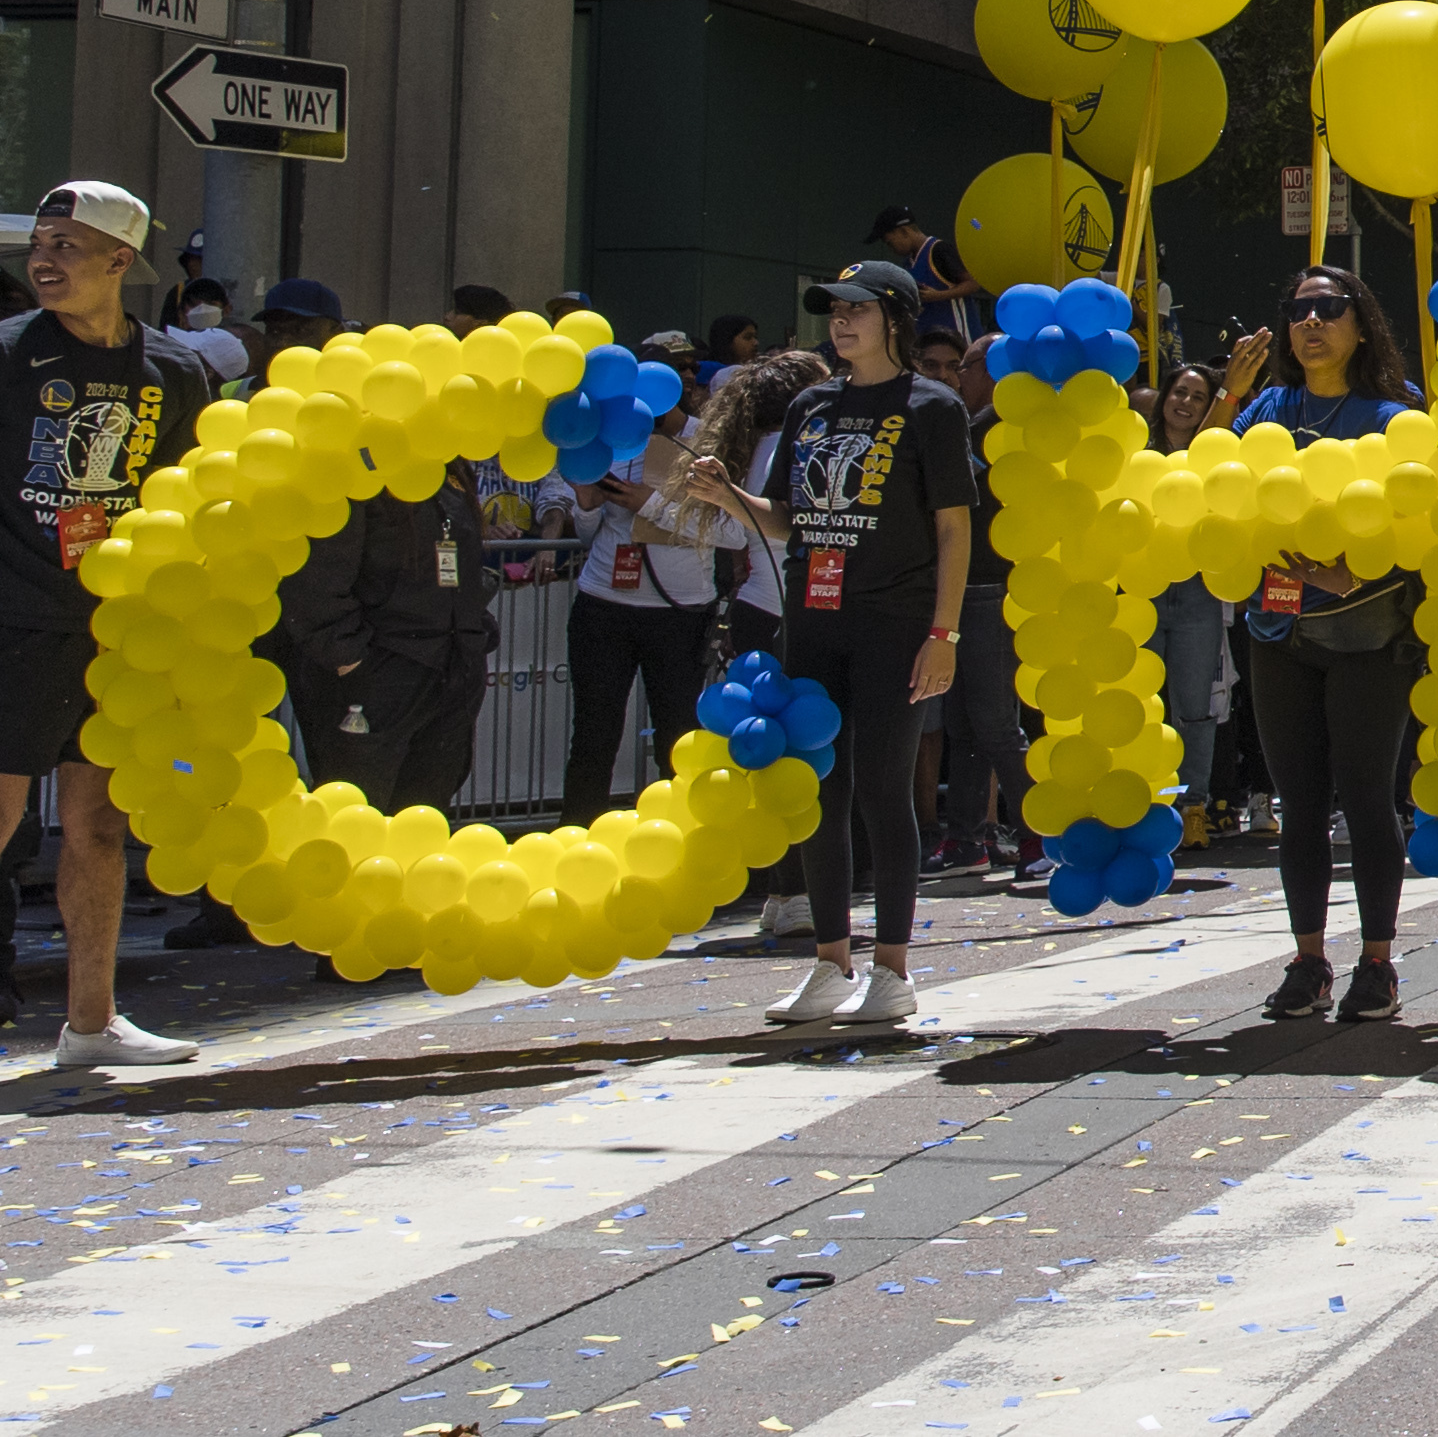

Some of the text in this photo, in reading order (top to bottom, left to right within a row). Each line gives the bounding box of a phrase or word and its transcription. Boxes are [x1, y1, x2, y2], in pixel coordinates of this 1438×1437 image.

[224, 80, 332, 126] ONE WAY
[1285, 169, 1302, 187] NO
[23, 415, 70, 489] NBA
[857, 414, 905, 507] CHAMPS
[485, 663, 549, 692] oogle
